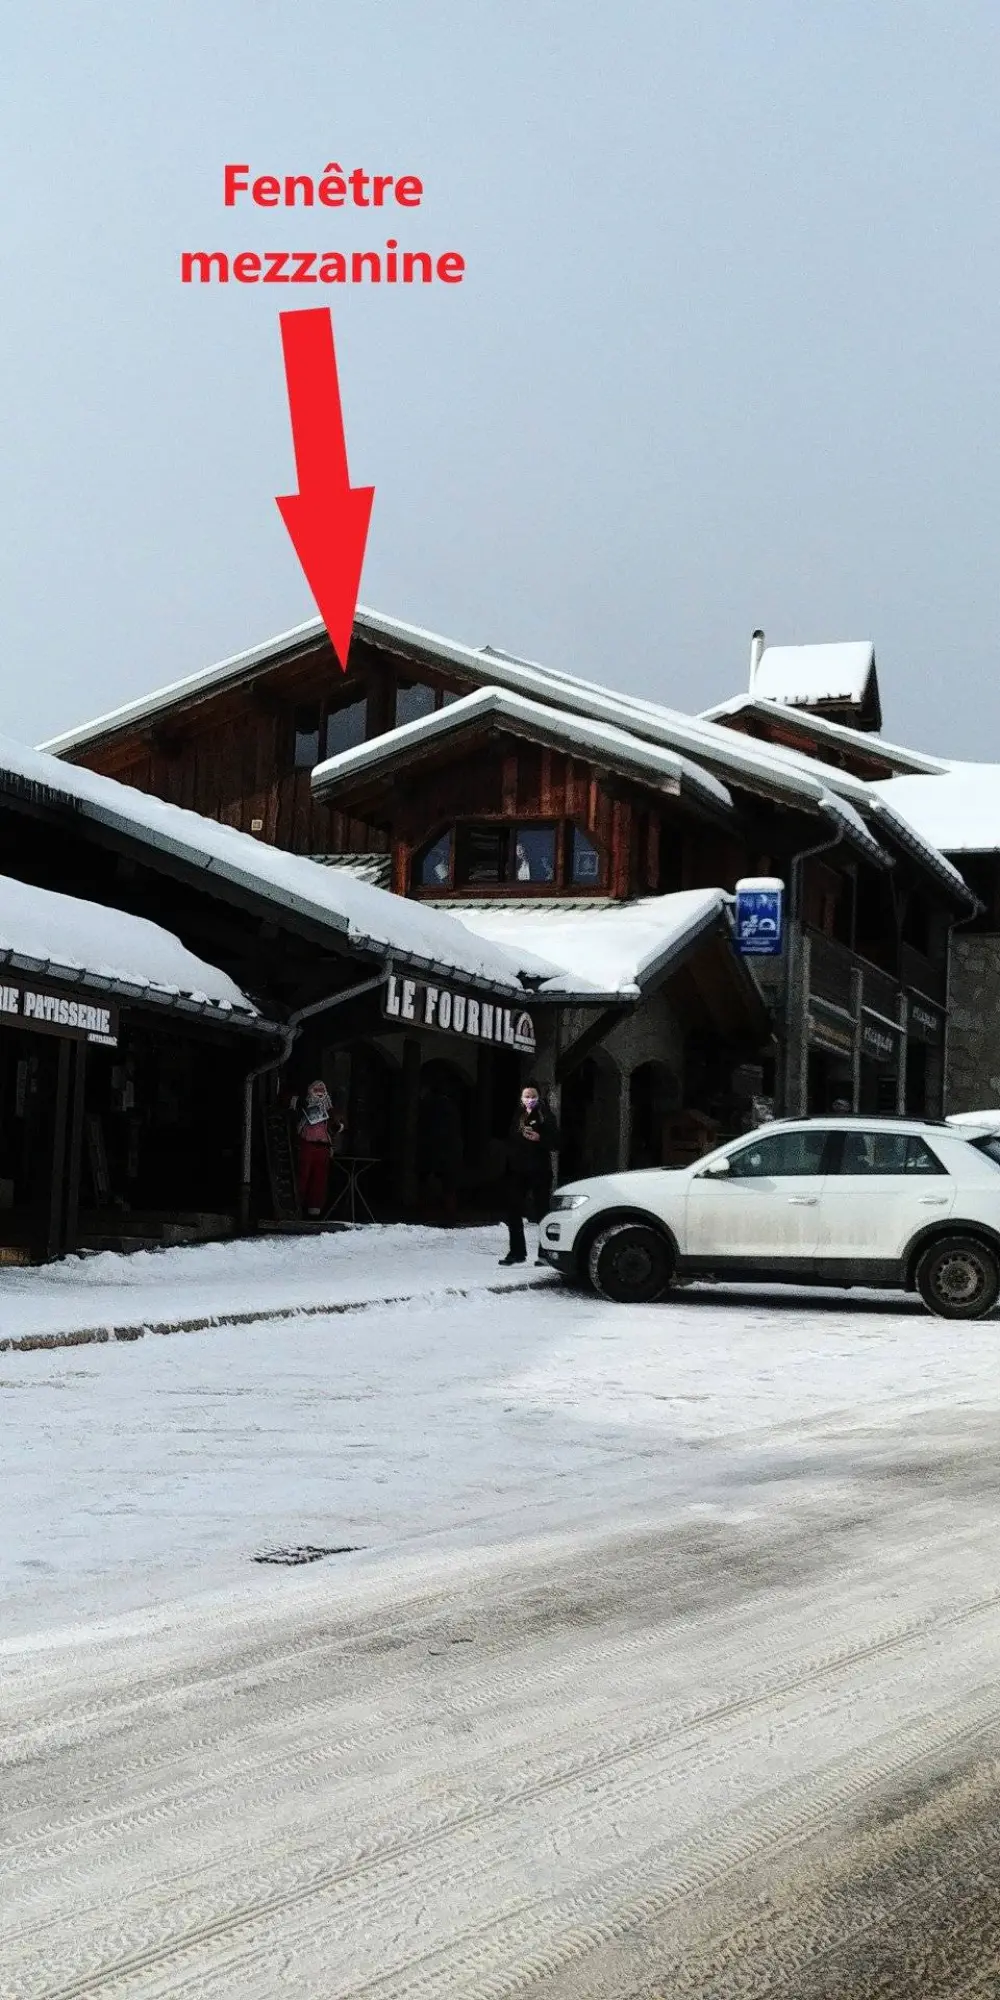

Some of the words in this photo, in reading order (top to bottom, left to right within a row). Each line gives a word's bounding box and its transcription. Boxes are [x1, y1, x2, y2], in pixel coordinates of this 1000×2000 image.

[0, 985, 19, 1014] IE
[23, 991, 111, 1034] PATISSERIE
[386, 975, 416, 1019] LE
[424, 987, 515, 1045] FOURNIL
